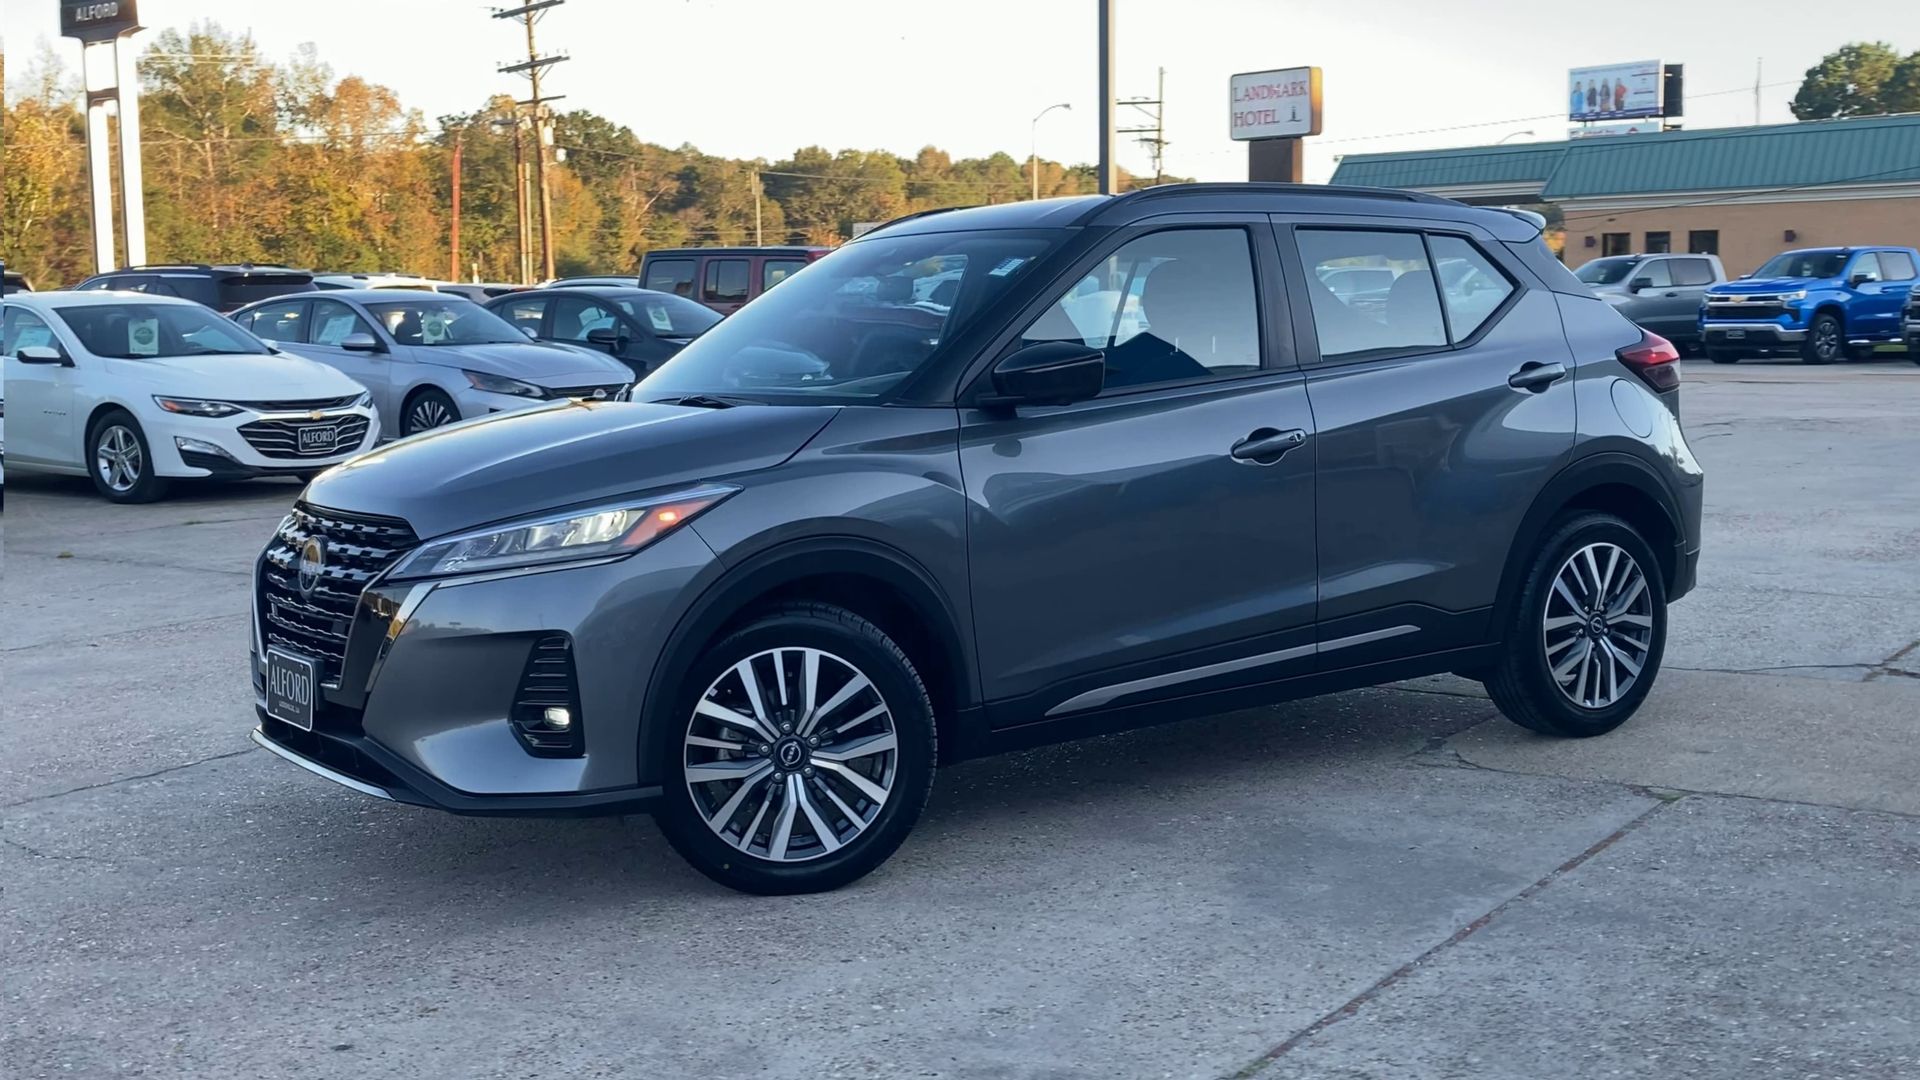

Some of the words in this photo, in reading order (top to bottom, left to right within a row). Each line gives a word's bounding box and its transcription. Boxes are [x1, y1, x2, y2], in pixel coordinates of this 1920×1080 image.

[76, 2, 118, 21] ALFORD
[1233, 80, 1308, 102] LANDMARK
[1233, 109, 1280, 127] HOTEL
[302, 431, 334, 443] ALFORD
[269, 664, 309, 705] ALFORD
